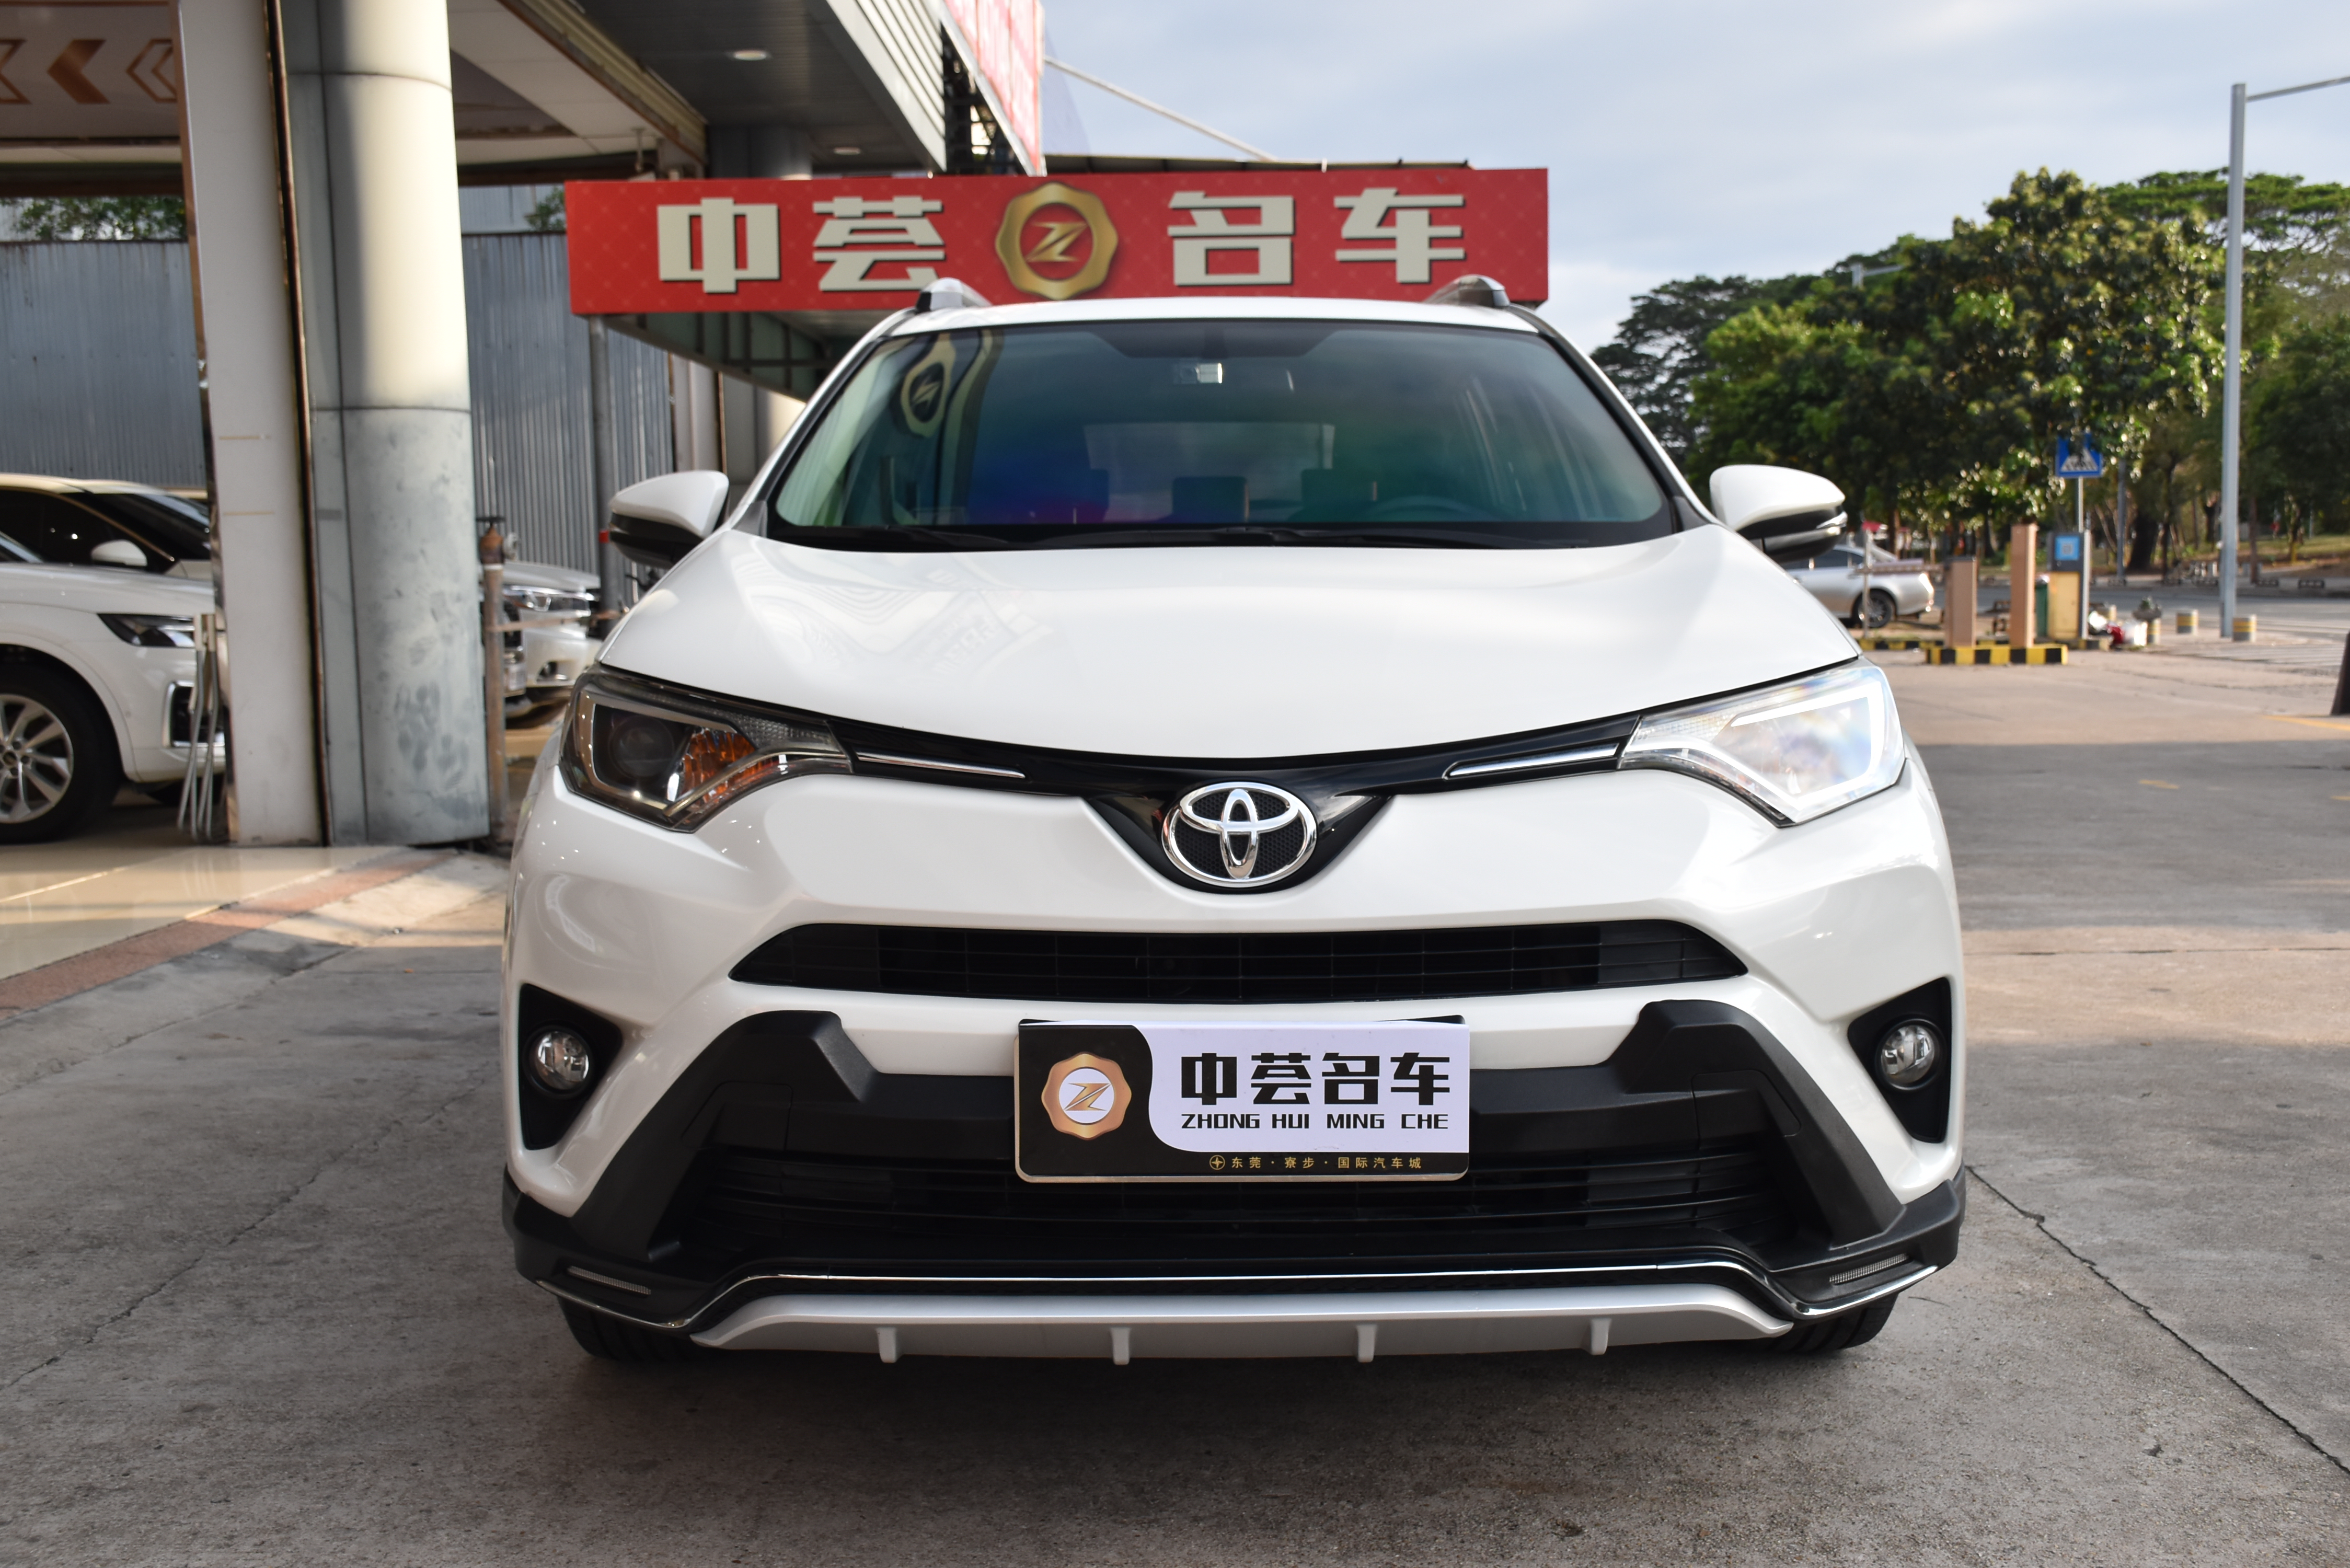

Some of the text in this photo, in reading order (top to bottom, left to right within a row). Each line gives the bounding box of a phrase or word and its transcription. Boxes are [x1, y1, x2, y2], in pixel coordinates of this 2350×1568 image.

[657, 195, 945, 293] 中荟
[1167, 188, 1466, 286] 名车
[1181, 1052, 1450, 1105] 中荟名车
[1181, 1114, 1448, 1129] ZHONG HUI MING CHE
